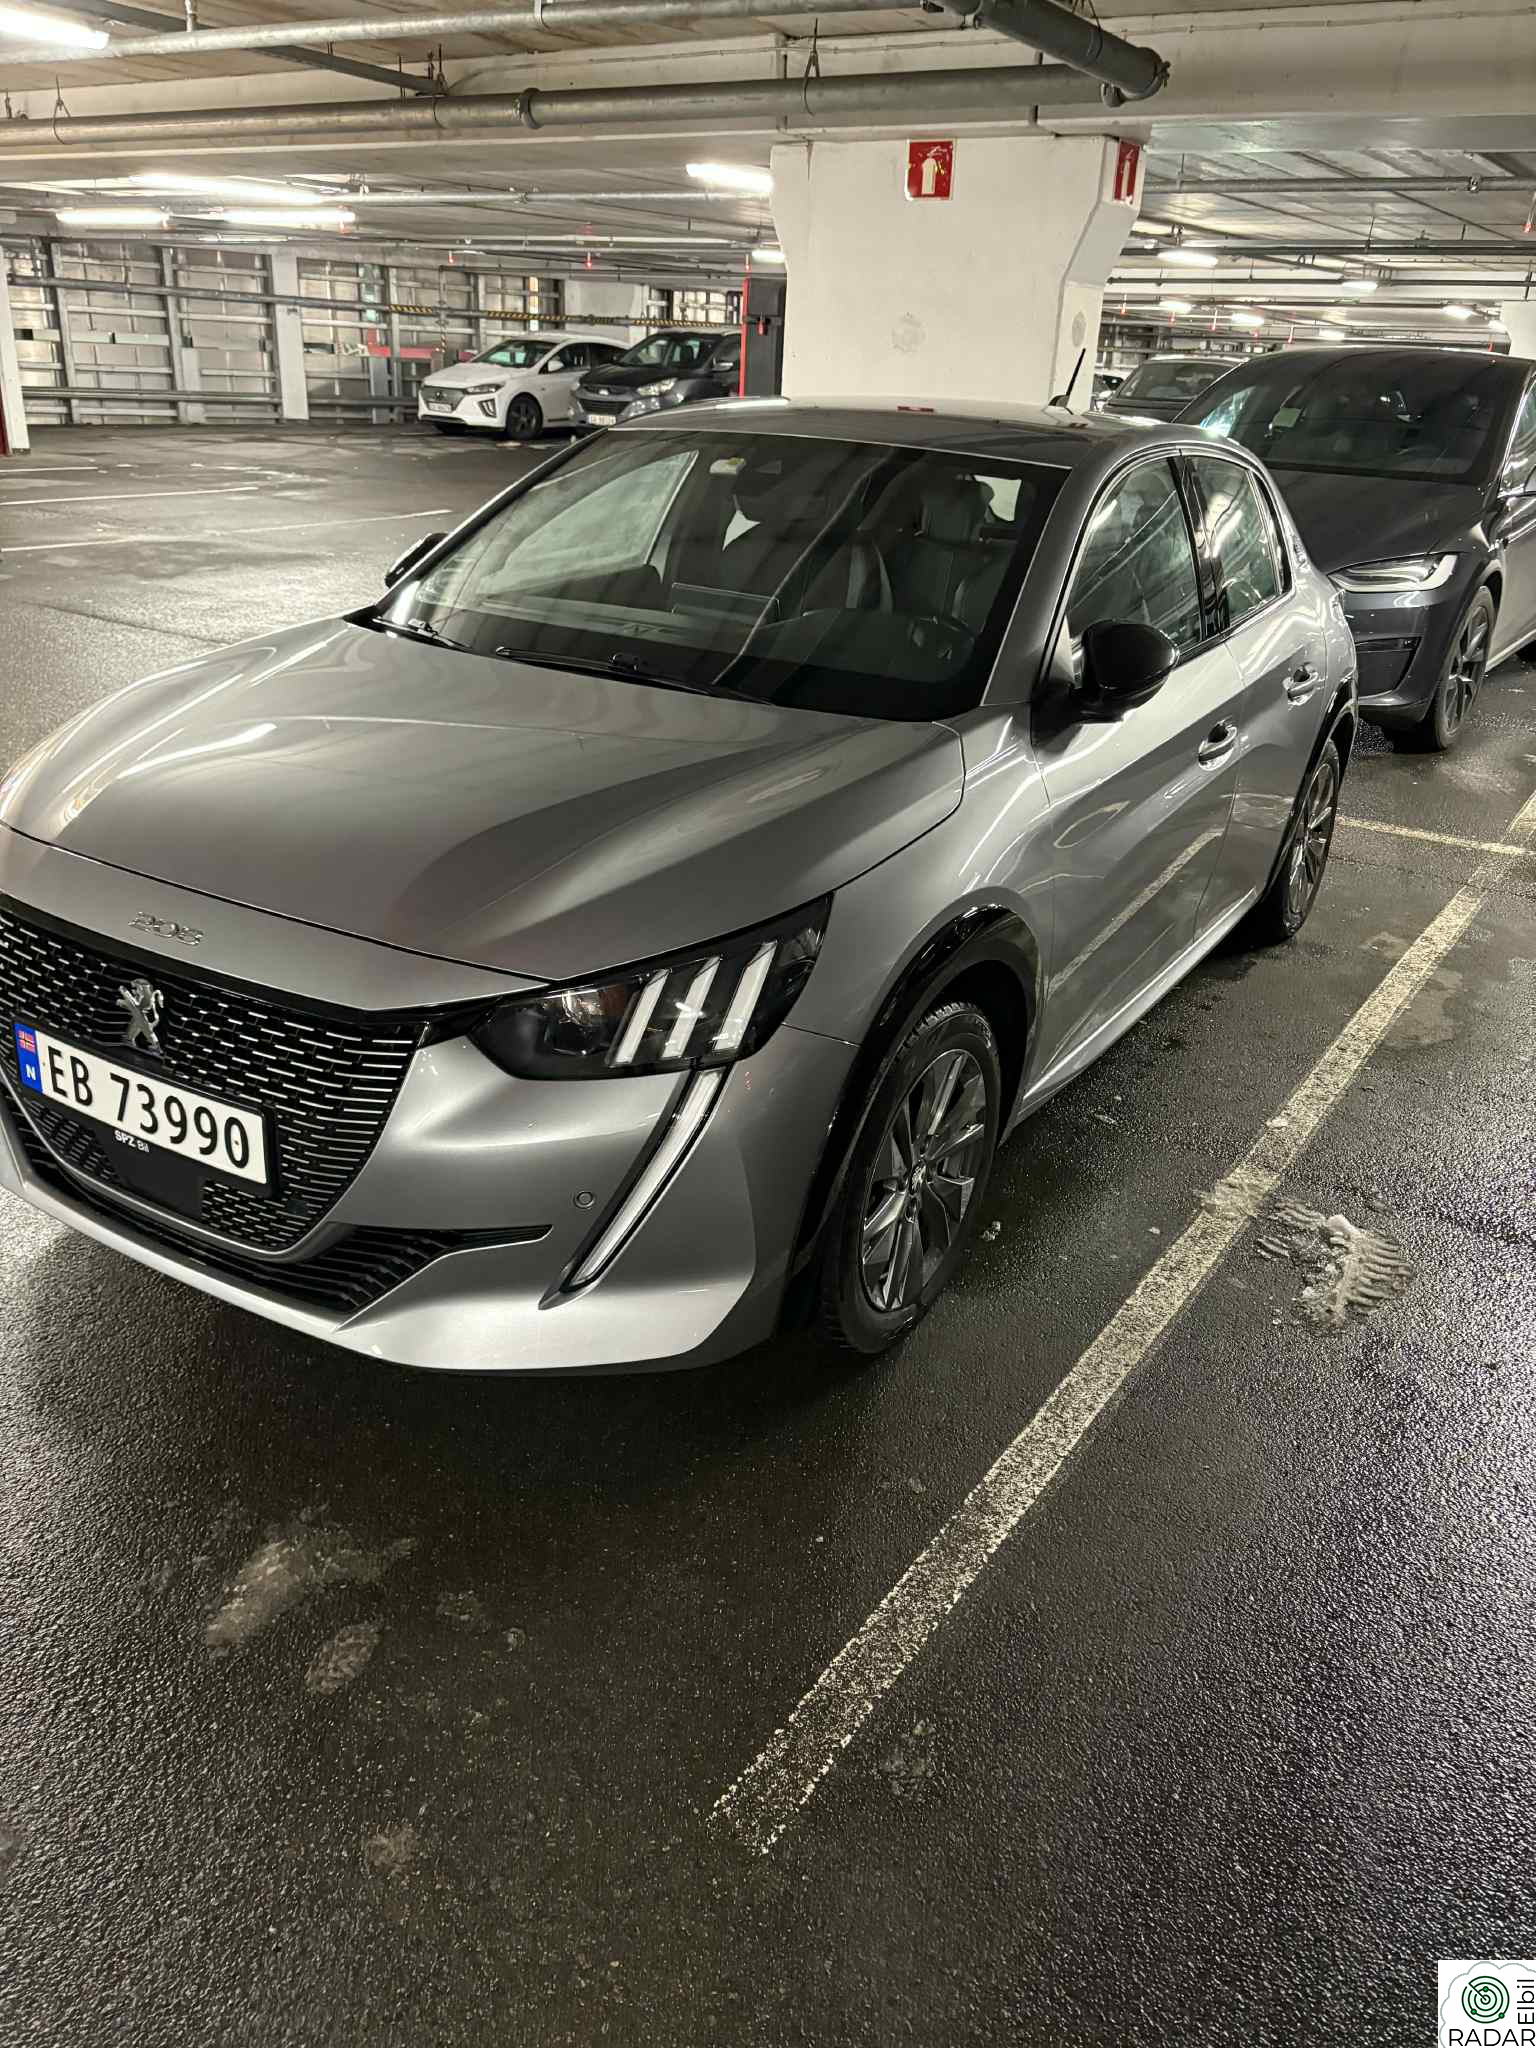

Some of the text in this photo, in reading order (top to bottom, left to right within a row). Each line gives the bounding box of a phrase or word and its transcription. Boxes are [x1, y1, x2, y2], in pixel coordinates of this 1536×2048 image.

[25, 1064, 36, 1081] N
[48, 1045, 249, 1168] EB 73990
